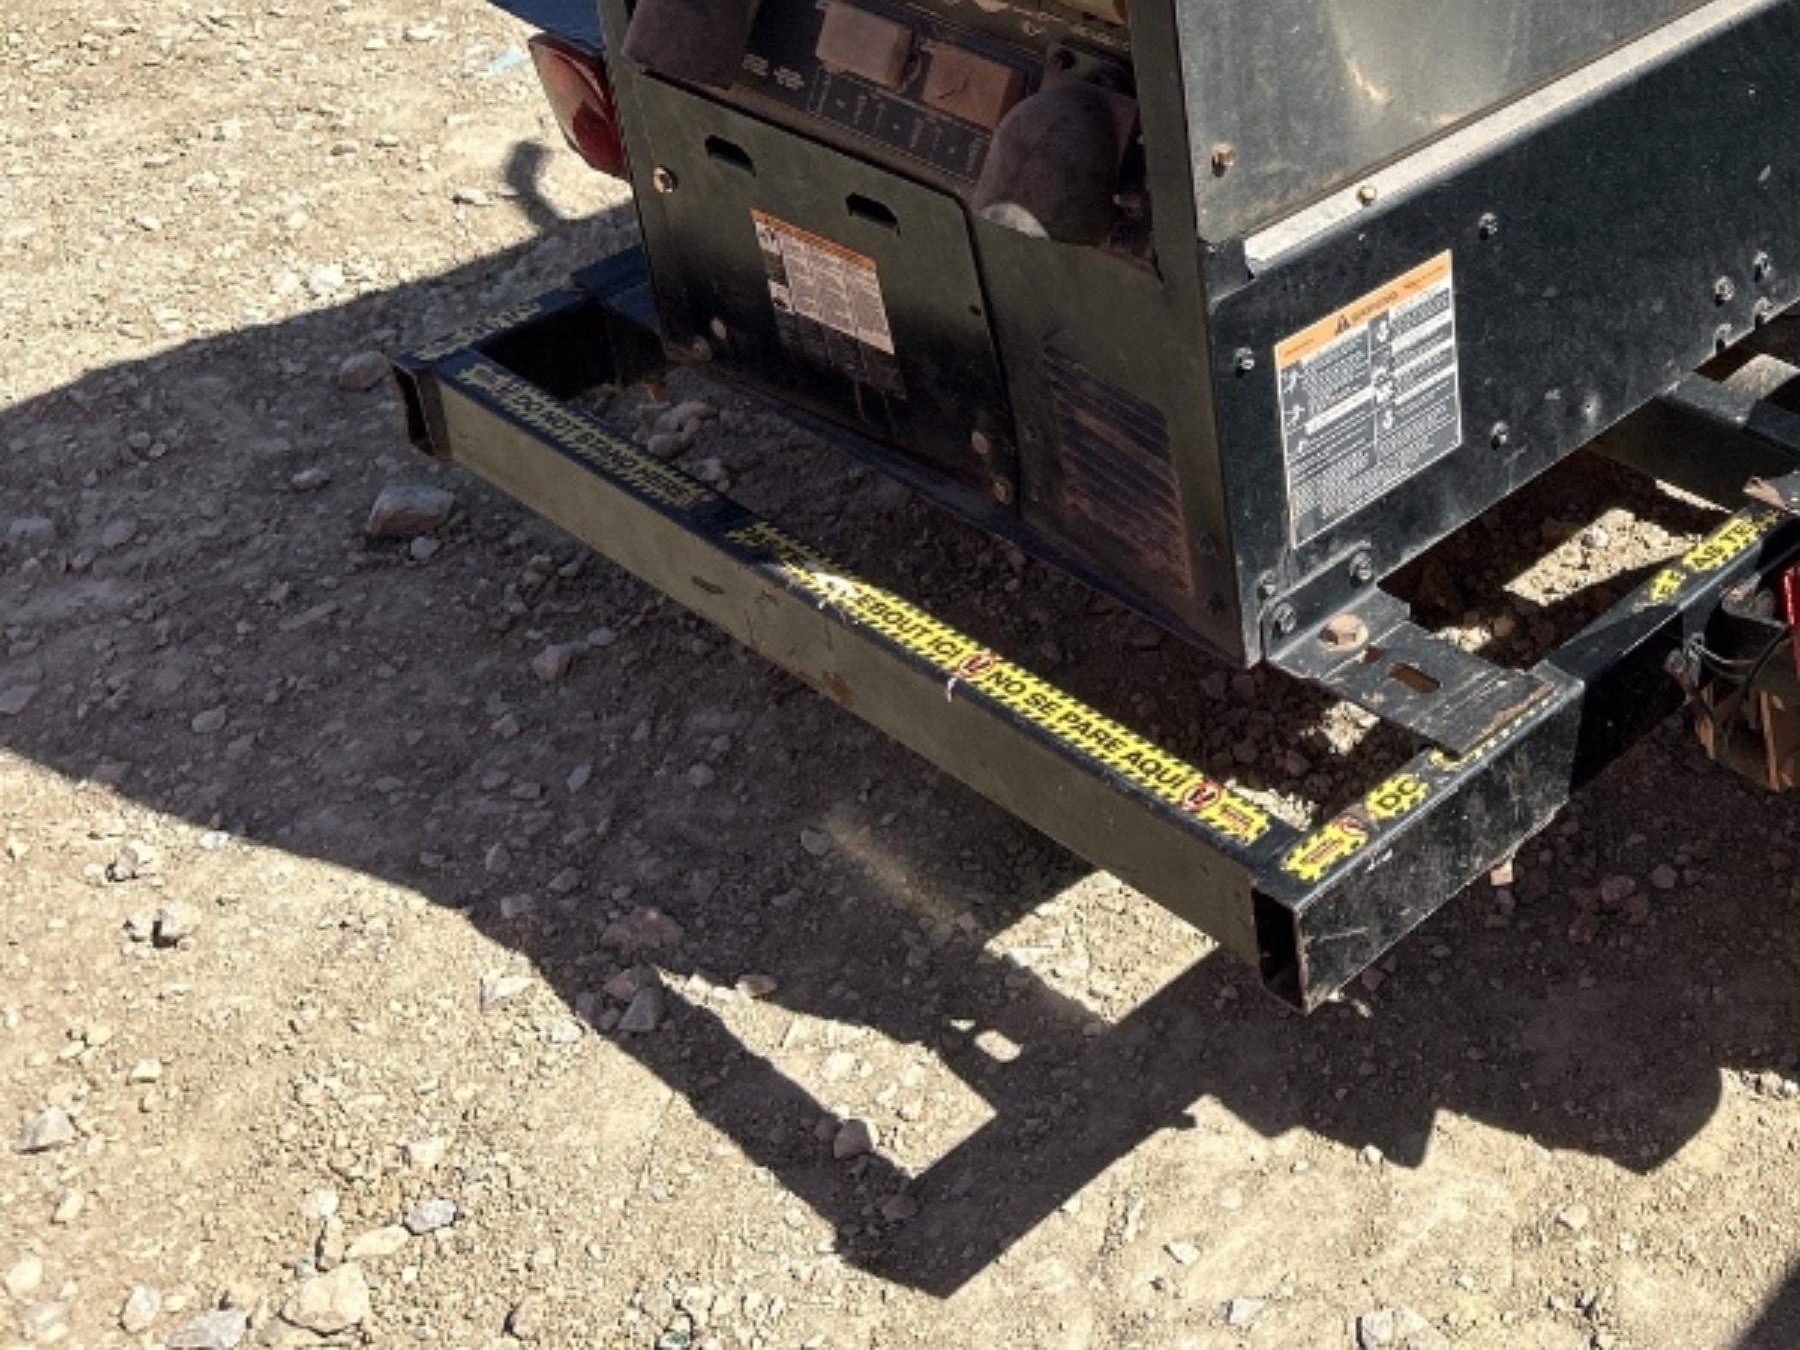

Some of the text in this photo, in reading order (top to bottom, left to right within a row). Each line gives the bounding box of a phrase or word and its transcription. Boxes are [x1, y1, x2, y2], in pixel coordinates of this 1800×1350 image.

[855, 593, 931, 638] EBOUT
[986, 668, 1025, 696] NO
[1022, 691, 1063, 717] SE
[1055, 710, 1129, 754] PARE
